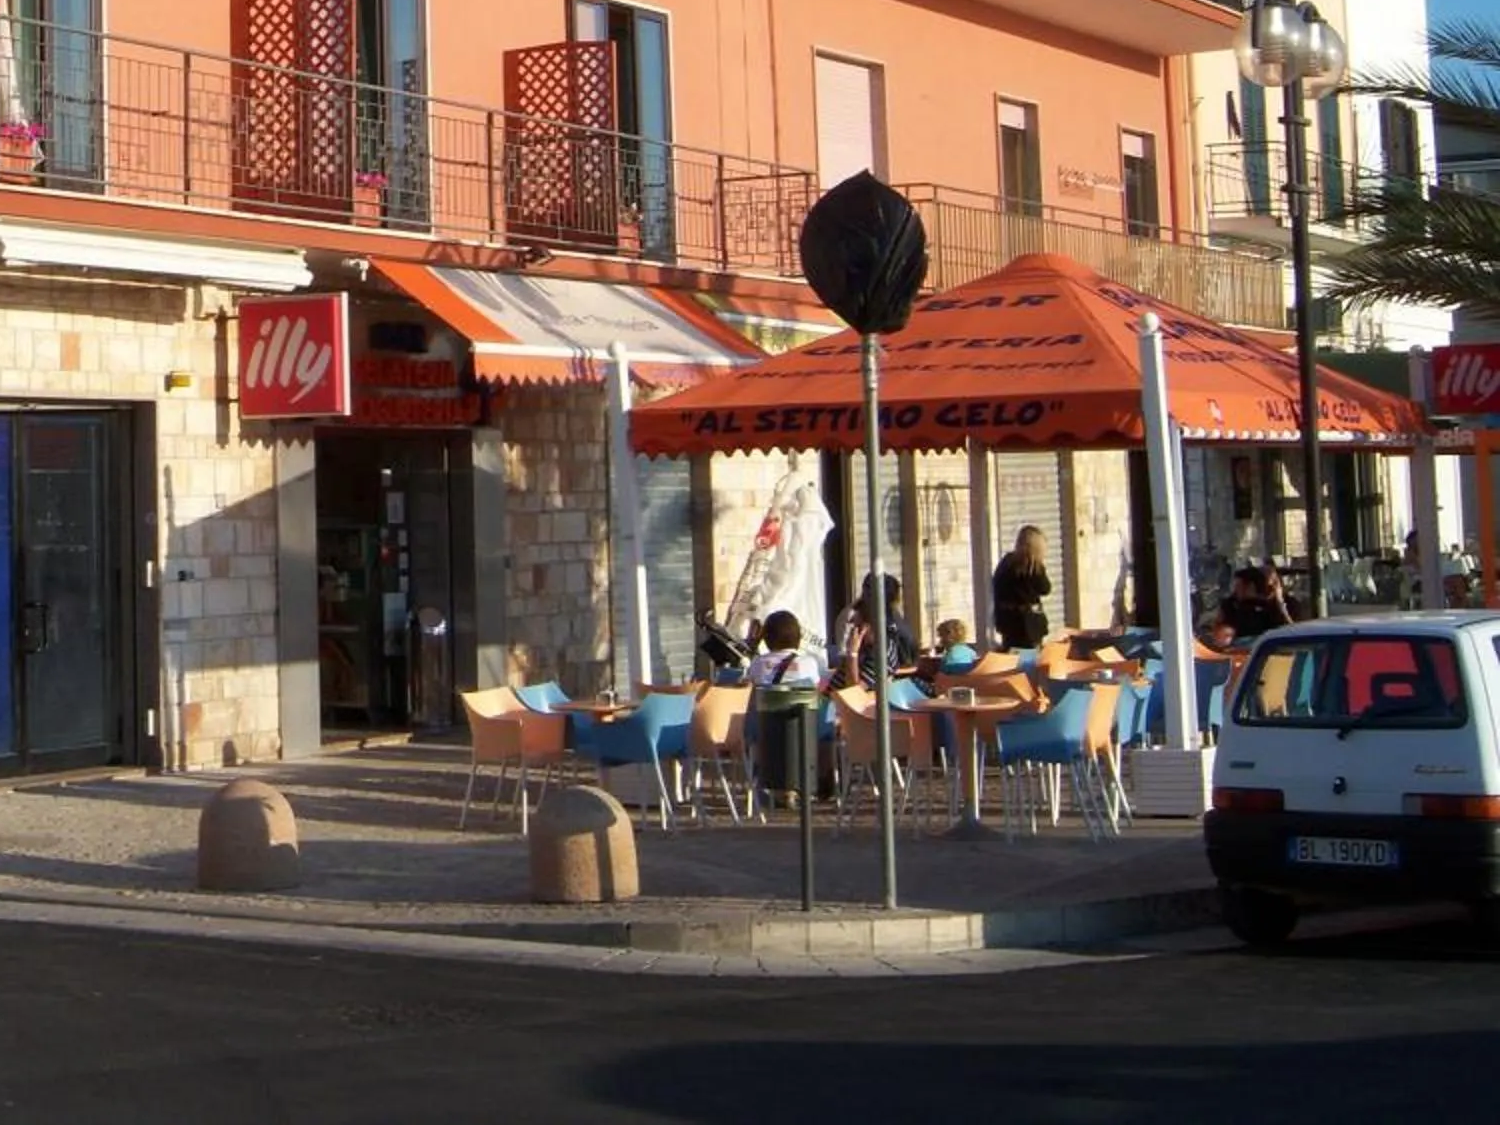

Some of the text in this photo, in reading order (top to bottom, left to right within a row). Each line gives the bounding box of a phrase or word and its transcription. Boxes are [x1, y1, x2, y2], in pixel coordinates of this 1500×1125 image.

[916, 293, 1060, 312] BAR
[245, 316, 332, 404] illy
[1440, 353, 1500, 406] illy
[1299, 839, 1322, 860] BL
